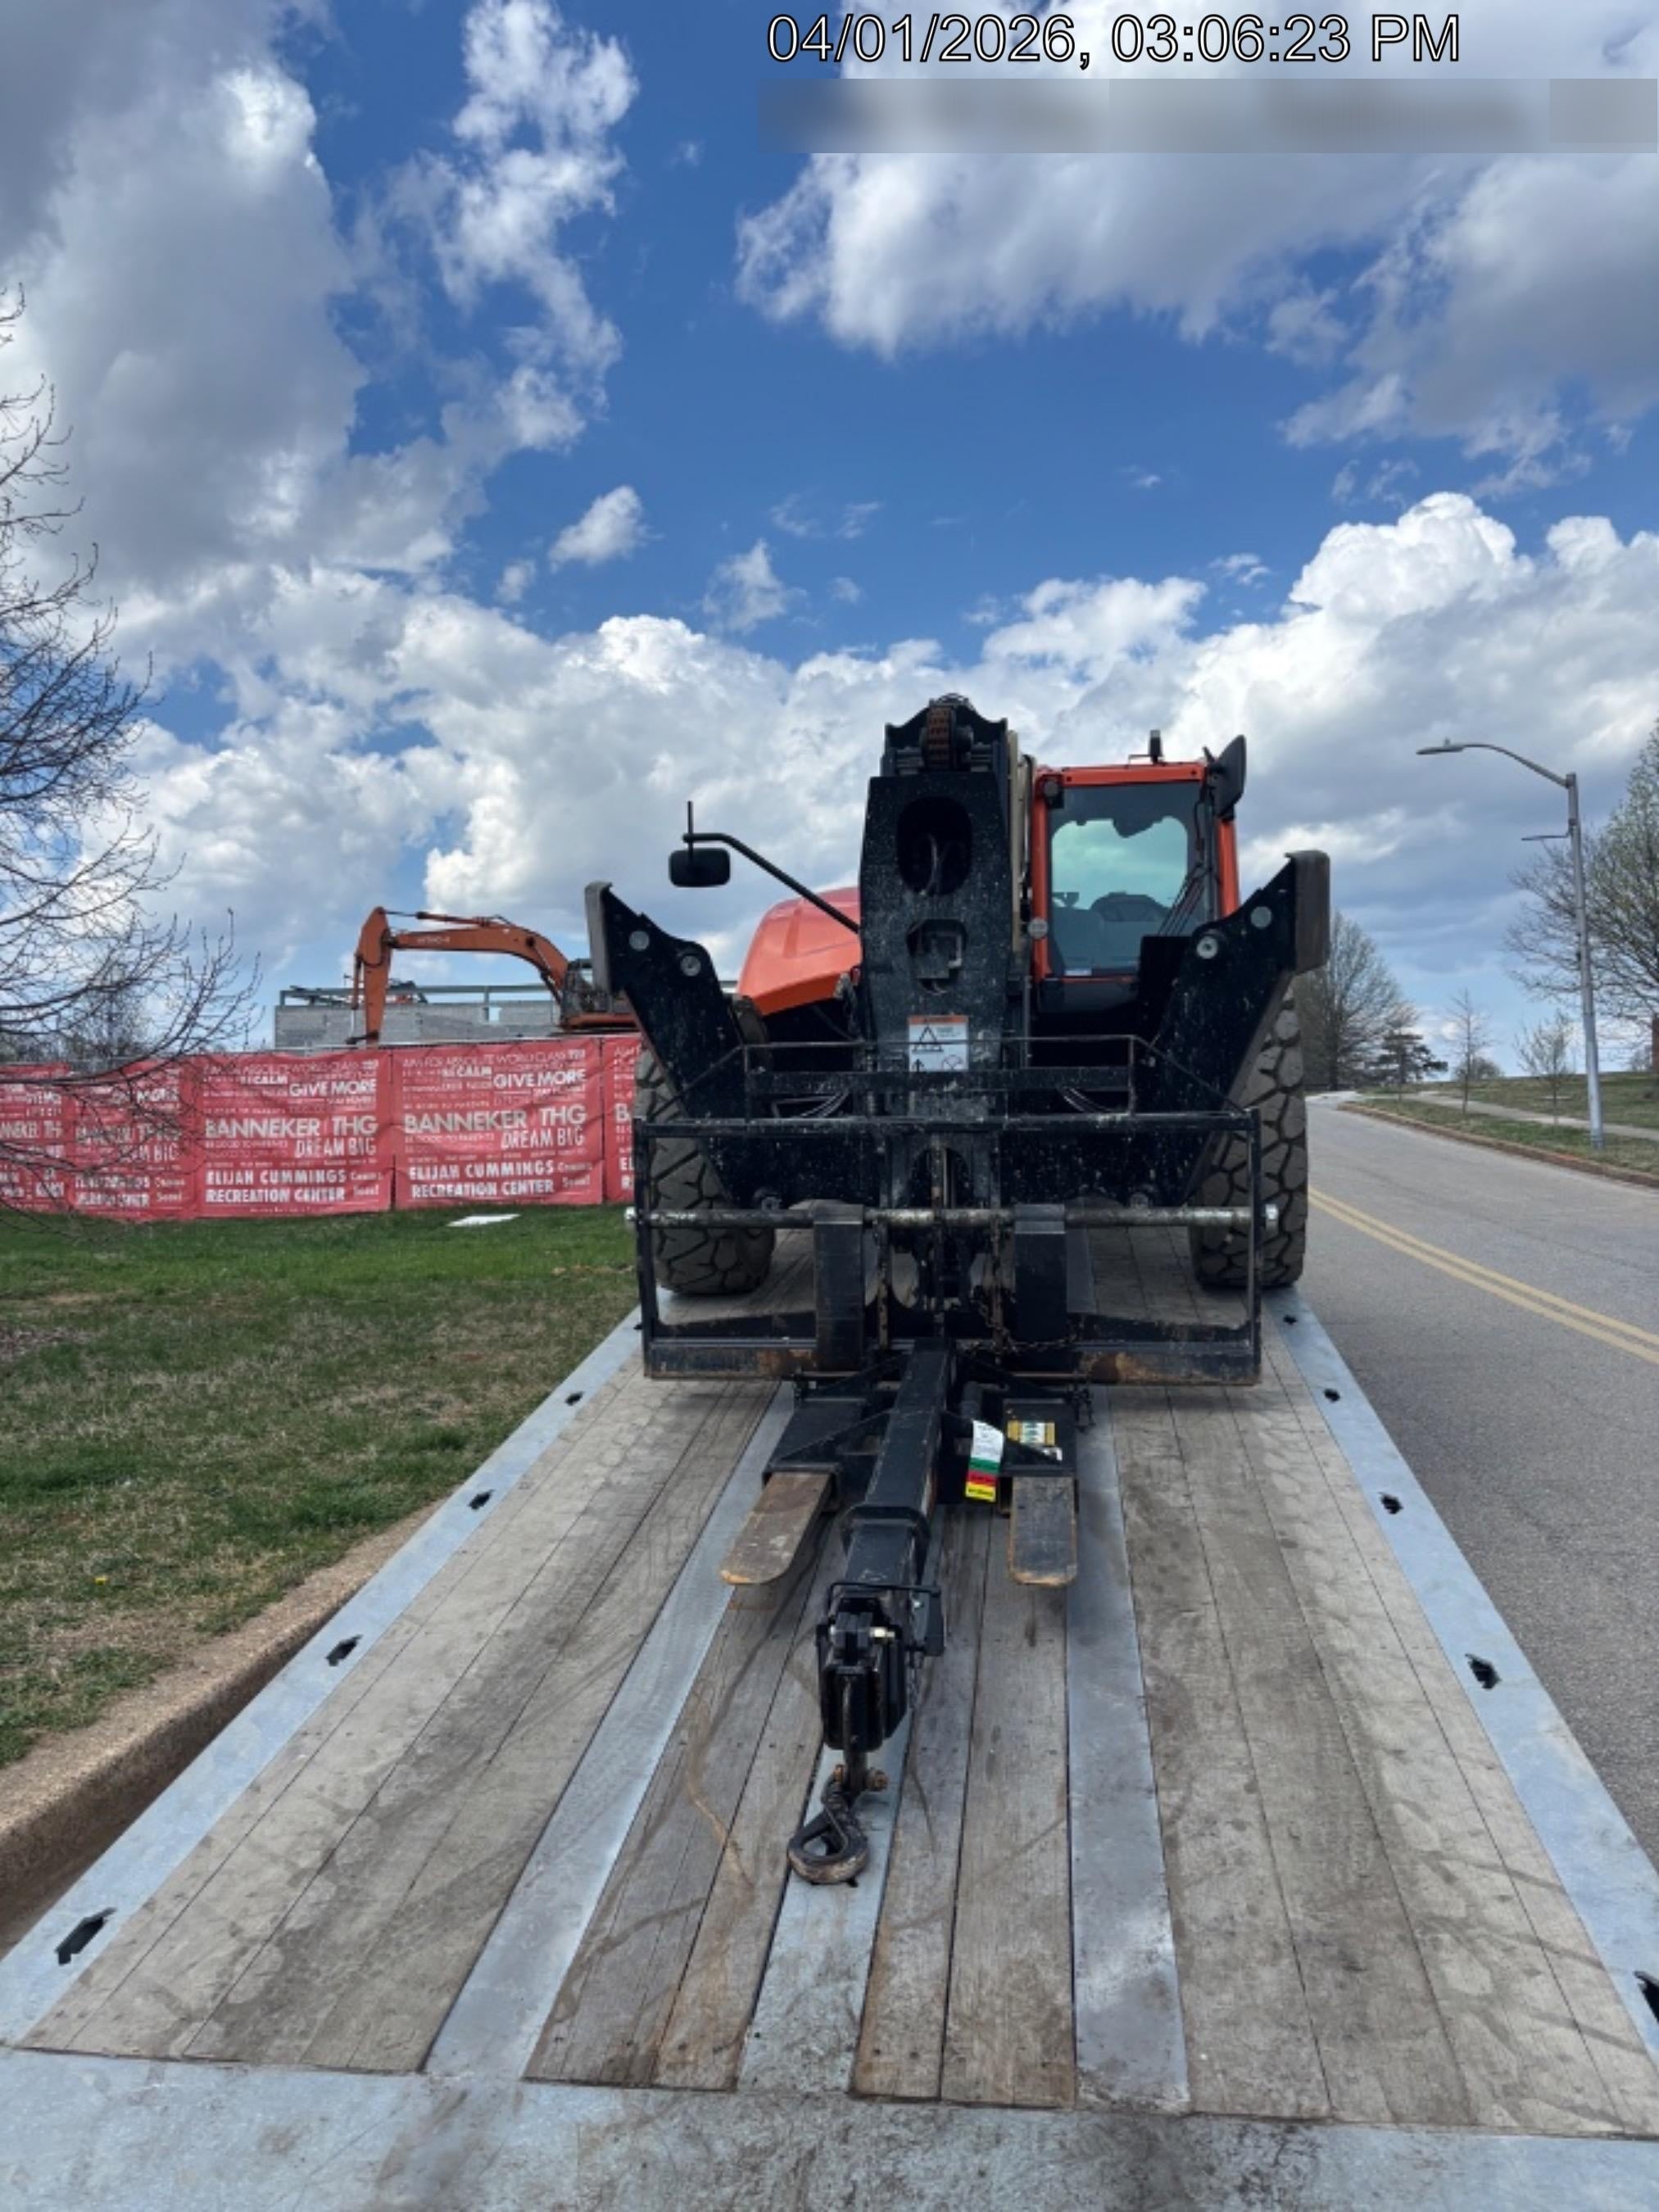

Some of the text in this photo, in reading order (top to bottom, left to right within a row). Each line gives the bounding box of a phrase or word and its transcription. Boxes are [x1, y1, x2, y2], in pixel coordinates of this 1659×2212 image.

[288, 1081, 328, 1097] GIVE
[330, 1078, 377, 1095] MORE
[493, 1072, 535, 1089] GIVE
[537, 1068, 586, 1086] MORE
[205, 1117, 320, 1139] BANNEKER
[332, 1114, 378, 1136] THG
[404, 1110, 527, 1135] BANNEKER
[539, 1103, 586, 1126] THG
[348, 1135, 377, 1157] BIG
[501, 1127, 554, 1150] DREAM
[557, 1125, 585, 1147] BIG
[206, 1170, 254, 1185] ELIJAH
[260, 1168, 347, 1185] CUMMINGS
[410, 1164, 460, 1181] ELIJAH
[465, 1159, 555, 1179] CUMMINGS
[205, 1187, 291, 1203] RECREATION
[411, 1181, 497, 1199] RECREATION
[501, 1179, 555, 1196] CENTER
